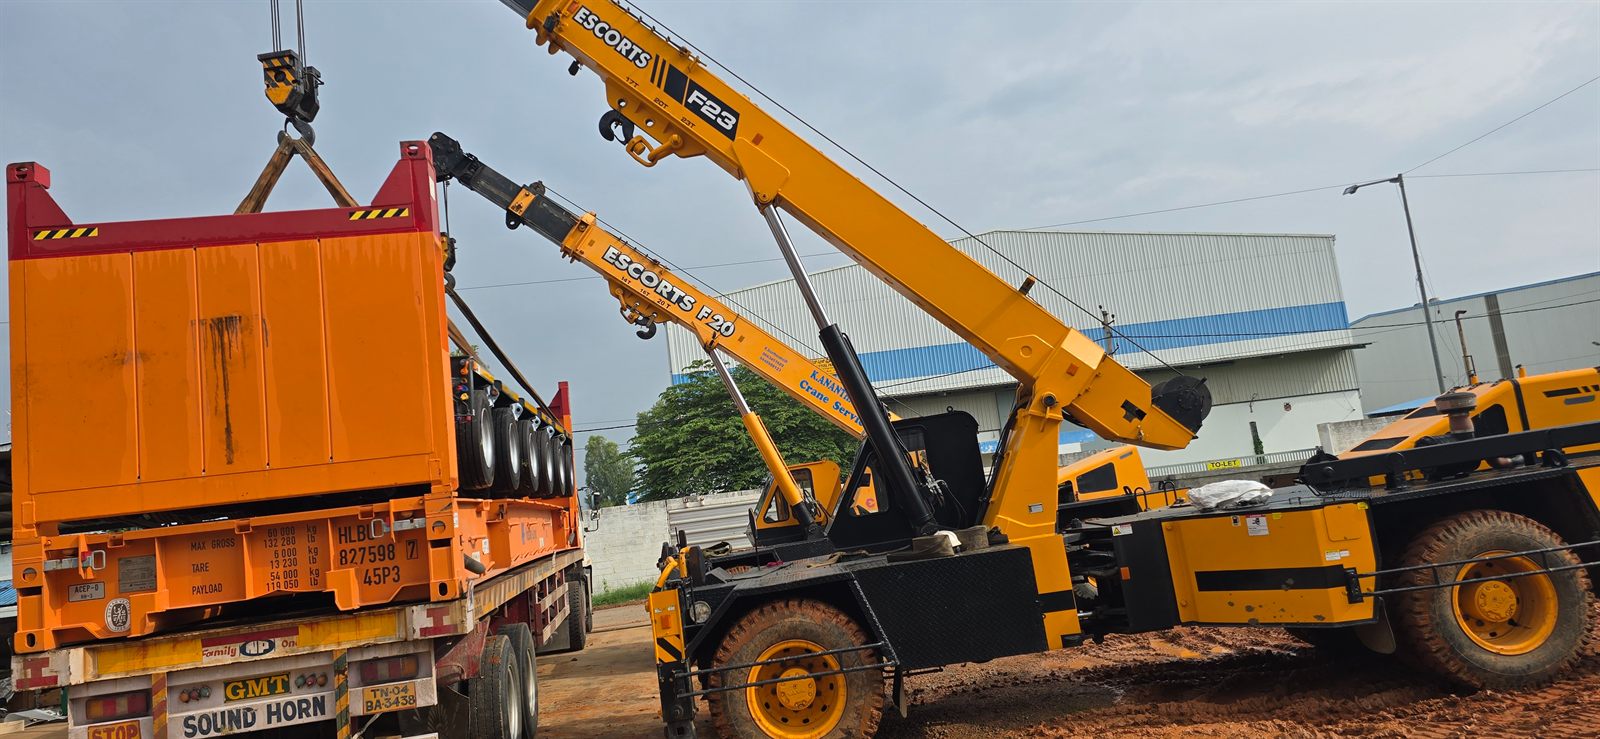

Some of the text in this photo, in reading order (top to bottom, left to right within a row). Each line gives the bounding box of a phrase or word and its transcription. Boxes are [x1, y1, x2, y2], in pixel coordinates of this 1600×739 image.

[572, 5, 738, 131] ESCORTS F23
[601, 245, 696, 311] ESCORTS
[799, 379, 830, 404] Crane
[1210, 459, 1236, 468] TO-LET
[280, 526, 296, 536] 000
[306, 523, 317, 534] kg
[191, 538, 236, 550] MAX GROSS
[264, 534, 315, 548] 132 280 lb
[274, 545, 318, 558] 6 000 kg
[340, 544, 395, 565] 827598
[192, 562, 209, 573] TARE
[270, 556, 317, 569] 13 230 lb
[270, 567, 320, 581] 54 000 kg
[363, 565, 401, 586] 45P3
[192, 583, 223, 595] PAYLOAD
[266, 578, 318, 592] 119 050 lb
[202, 645, 237, 658] Family
[225, 674, 289, 700] GMT
[183, 695, 326, 738] SOUND HORN
